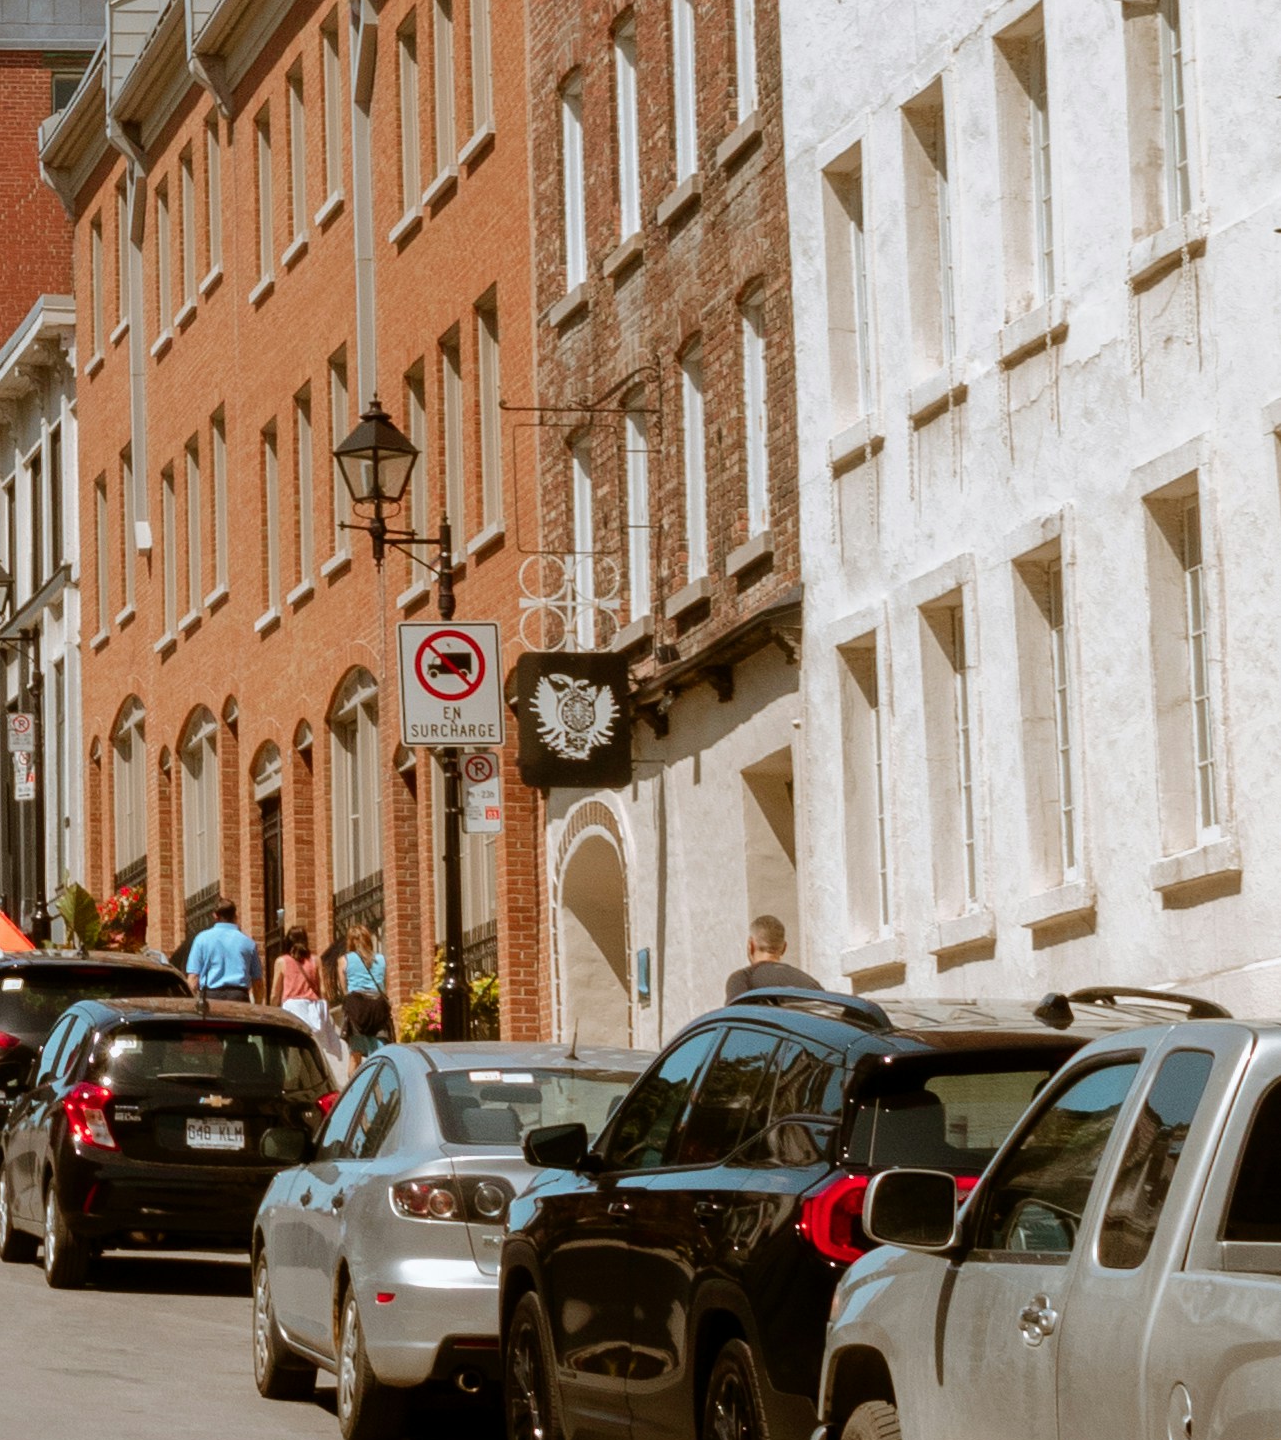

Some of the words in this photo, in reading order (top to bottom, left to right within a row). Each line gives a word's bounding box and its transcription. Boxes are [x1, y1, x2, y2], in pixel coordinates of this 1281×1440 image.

[443, 706, 462, 720] EN
[411, 723, 496, 738] SURCHARGE
[219, 1126, 244, 1142] KLM
